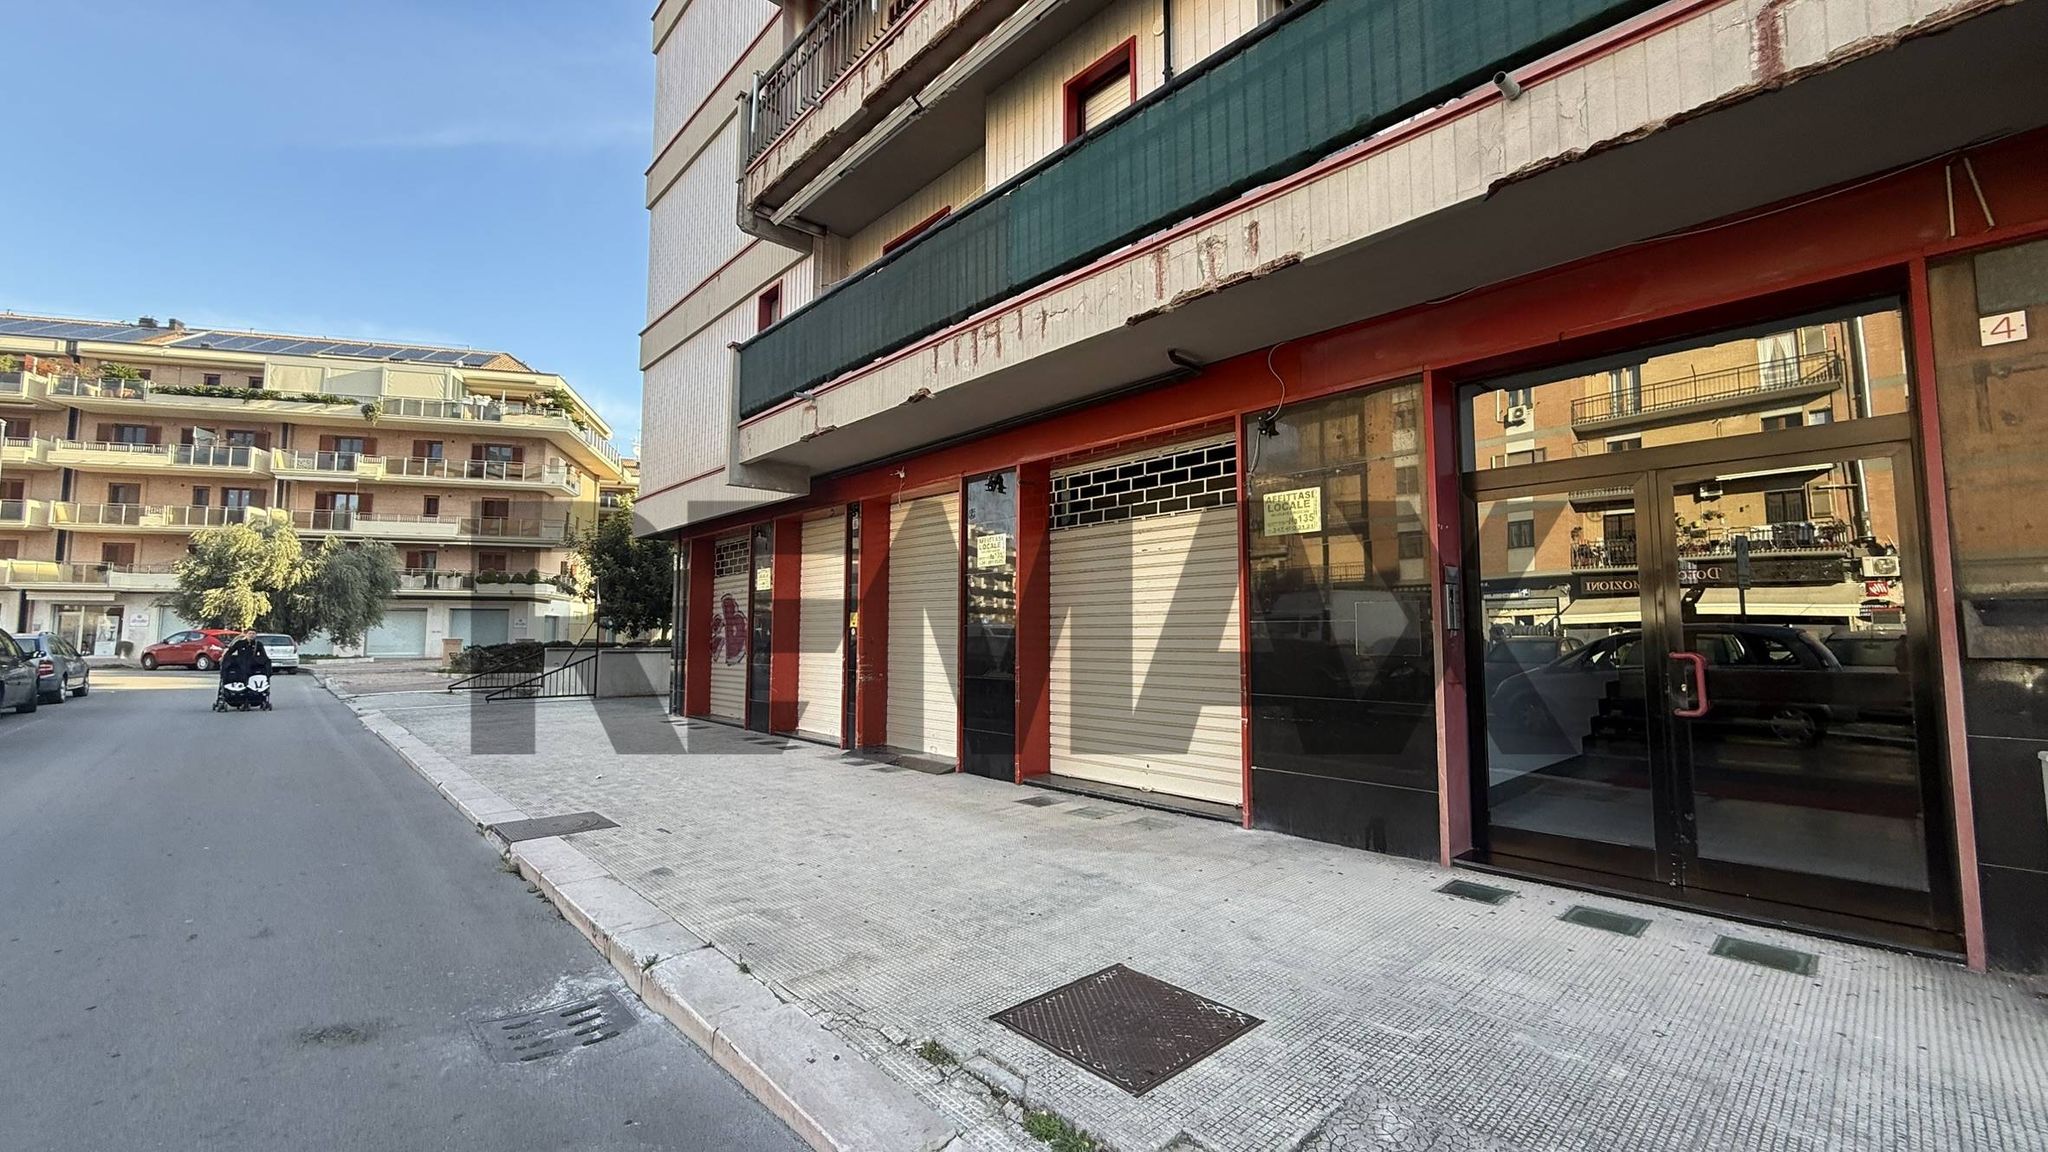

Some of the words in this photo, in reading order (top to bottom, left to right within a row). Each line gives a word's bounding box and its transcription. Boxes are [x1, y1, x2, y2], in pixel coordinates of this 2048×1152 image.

[1990, 316, 2017, 339] 4
[1265, 490, 1314, 504] AFFITTASI
[1267, 499, 1311, 513] LOCALE
